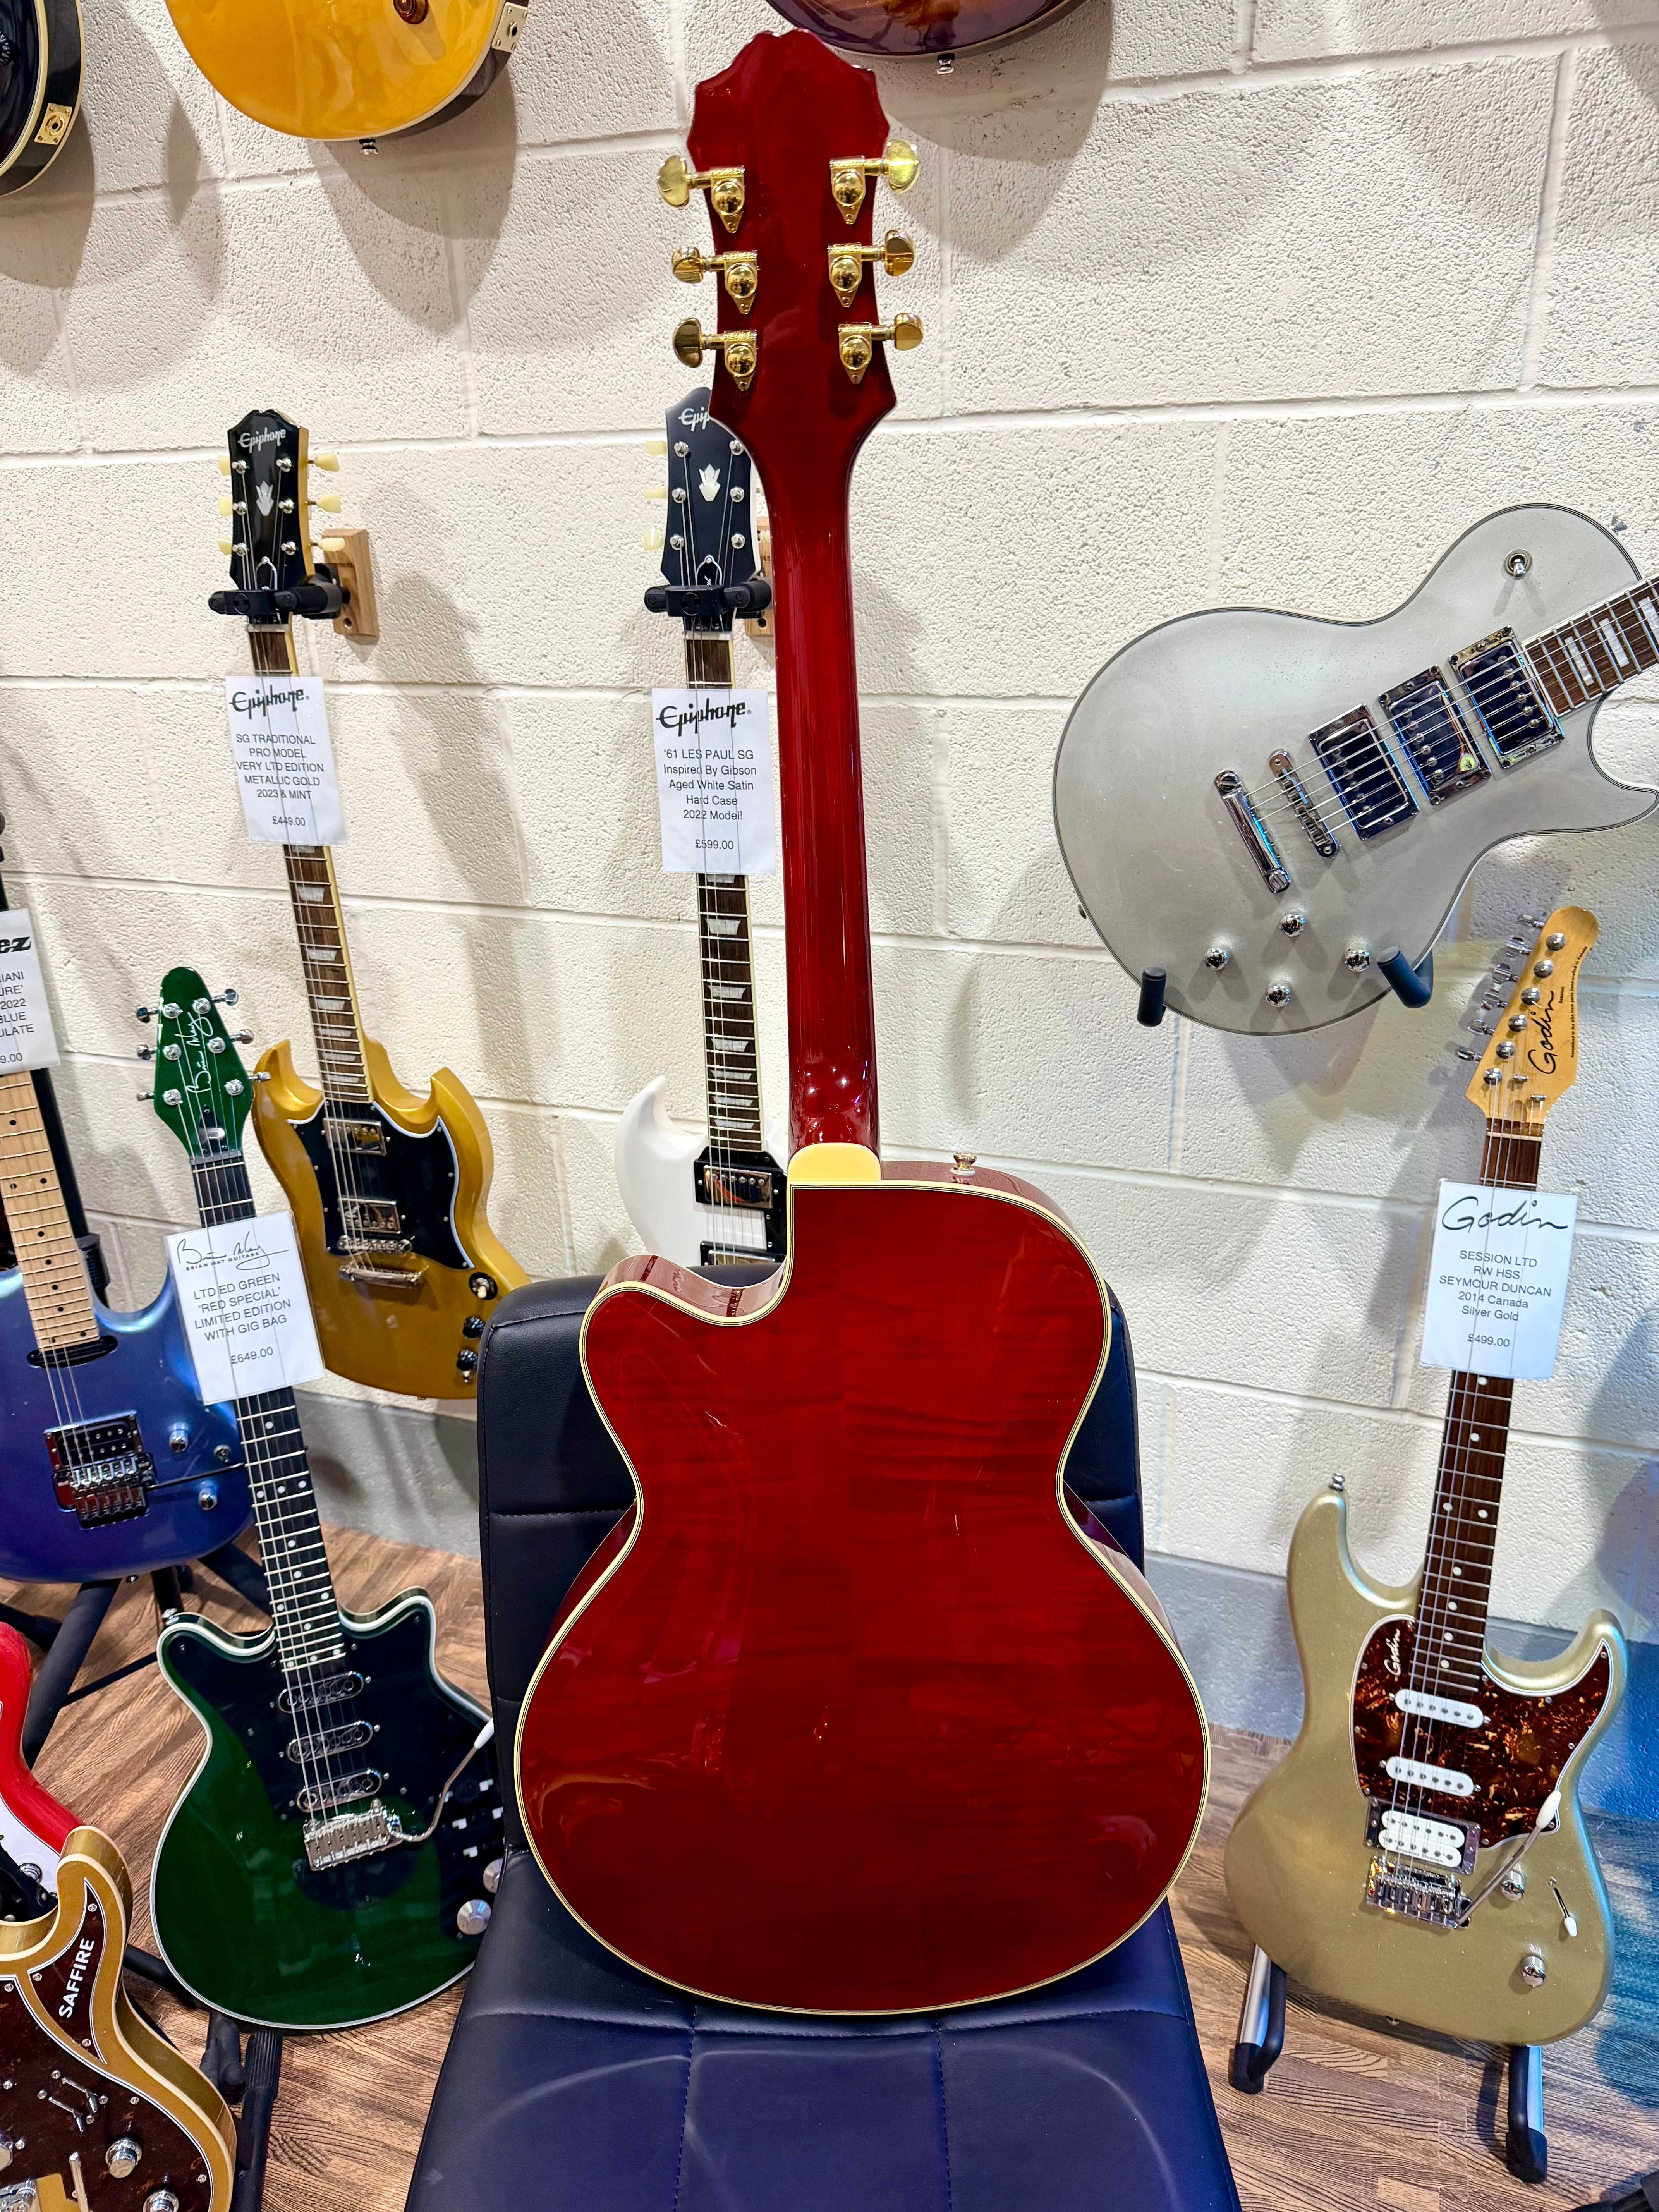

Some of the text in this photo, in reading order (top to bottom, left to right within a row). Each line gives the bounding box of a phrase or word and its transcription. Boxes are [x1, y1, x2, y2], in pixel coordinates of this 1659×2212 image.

[678, 406, 710, 431] Epip
[237, 427, 286, 453] Epiphone
[236, 734, 316, 744] SG TRADITIONAL
[250, 748, 306, 758] PRO MODEL
[682, 750, 702, 759] LES
[706, 750, 734, 759] PAUL
[738, 750, 754, 759] SG
[236, 762, 324, 772] VERY LTD EDITION
[664, 764, 757, 777] Inspired By Gibson
[244, 776, 320, 786] METALLIC GOLD
[669, 780, 754, 791] Aged White Satin
[257, 790, 278, 798] 2023
[289, 790, 312, 799] MINT
[686, 795, 738, 805] Hard Case
[272, 816, 305, 826] £449.00
[683, 810, 742, 820] 2022 Model!
[695, 840, 734, 850] £599.00
[0, 972, 24, 982] IANI
[0, 998, 26, 1009] 2022
[1528, 991, 1558, 1075] Godin
[1441, 1196, 1568, 1233] Godin
[228, 1252, 259, 1262] GUITARS
[1460, 1250, 1537, 1267] SESSION LTD
[1474, 1266, 1520, 1279] RW HSS
[194, 1273, 280, 1300] LTD ED GREEN
[1439, 1276, 1552, 1297] SEYMOUR DUNCAN
[1458, 1292, 1528, 1308] 2014 Canada
[194, 1299, 291, 1329] LIMITED EDITION
[1462, 1306, 1519, 1321] Silver Gold
[204, 1314, 287, 1341] WITH GIG BAG
[1467, 1334, 1510, 1347] £499.00
[231, 1346, 273, 1365] £649.00
[1384, 1628, 1401, 1676] Godin
[58, 1938, 94, 2018] SAFFIRE
